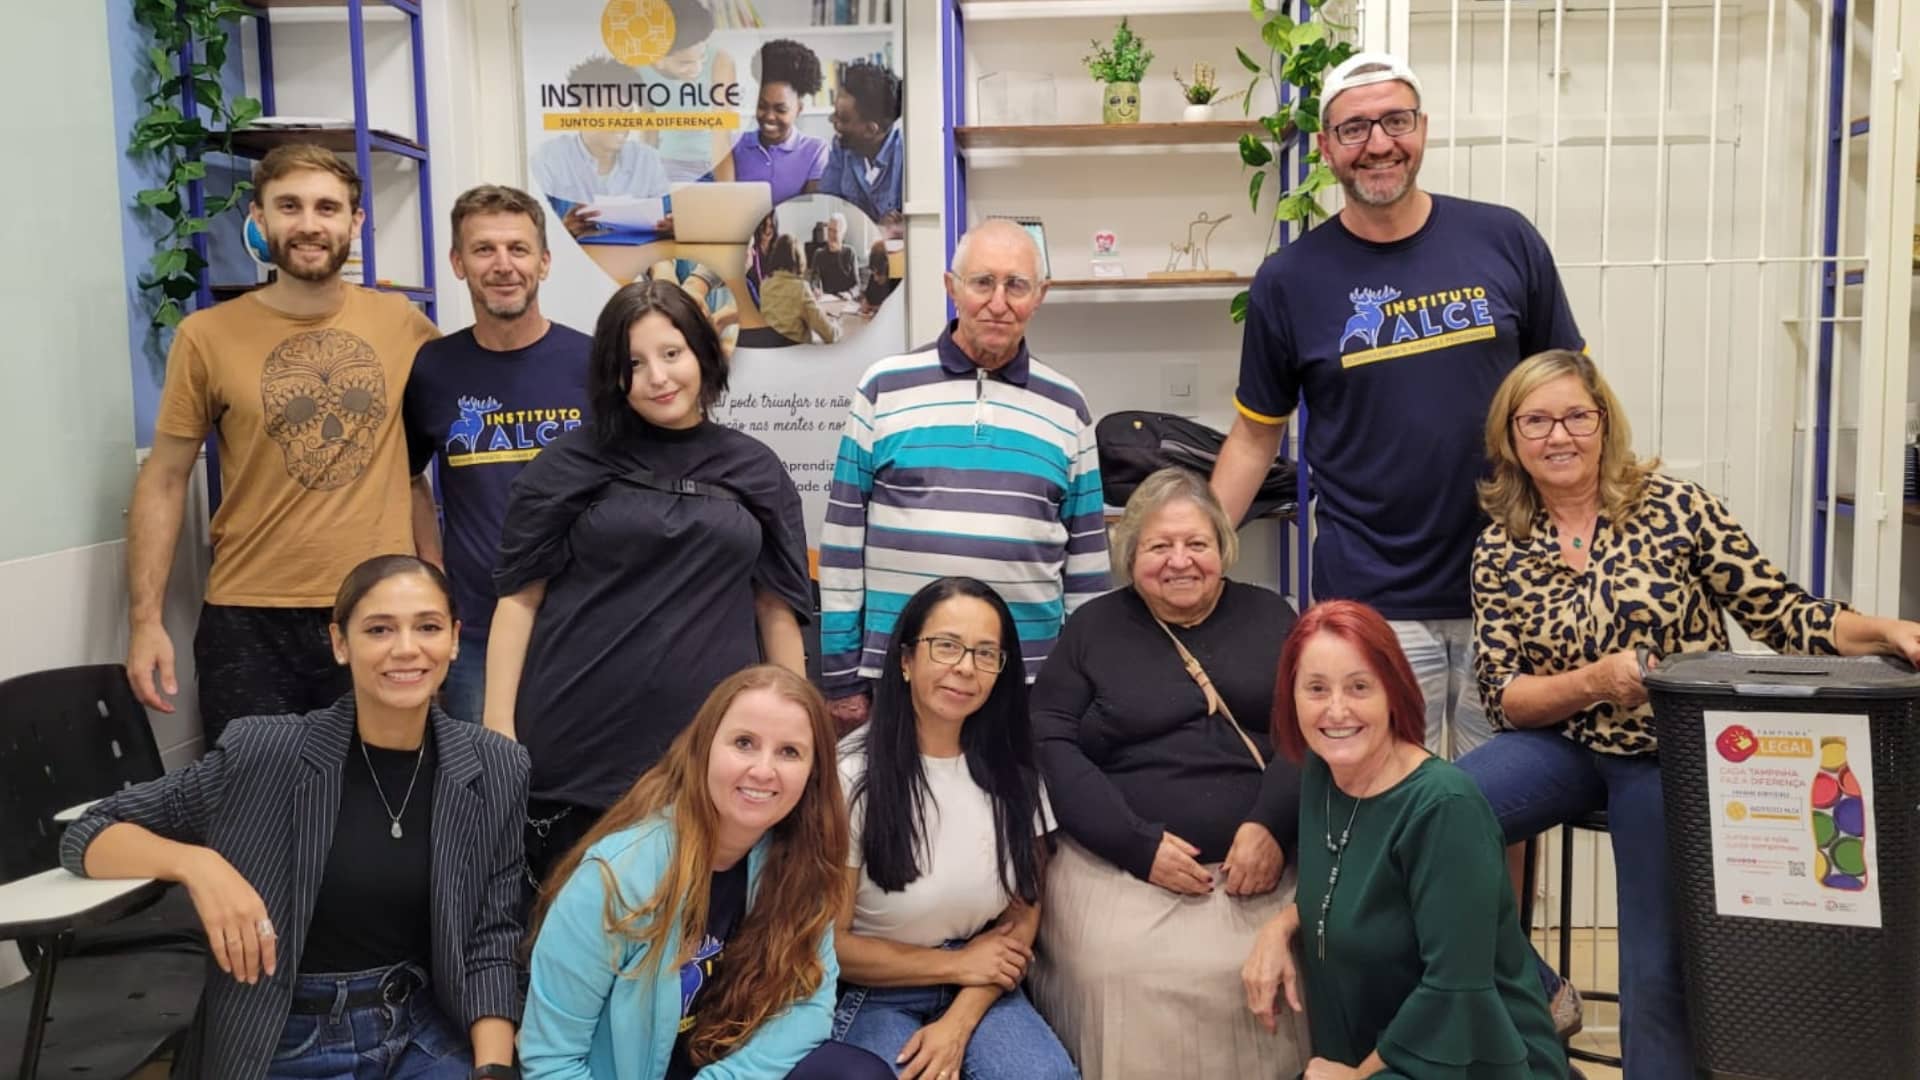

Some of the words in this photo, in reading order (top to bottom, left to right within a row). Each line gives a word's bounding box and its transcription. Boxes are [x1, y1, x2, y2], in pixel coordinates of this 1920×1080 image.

[541, 83, 671, 107] INSTITUTO
[680, 82, 740, 107] ALCE
[560, 118, 605, 128] JUNTOS
[607, 118, 642, 128] FAZER
[646, 118, 653, 127] A
[656, 117, 723, 129] DIFERENÇA
[1385, 287, 1486, 316] INSTITUTO
[1392, 299, 1494, 343] ALCE
[728, 394, 757, 415] pode
[761, 393, 812, 416] triunfar
[814, 398, 828, 408] se
[829, 395, 851, 408] não
[486, 408, 581, 426] INSTITUTO
[749, 420, 769, 431] nas
[773, 417, 814, 431] mentes
[817, 420, 826, 431] e
[1761, 740, 1809, 753] LEGAL
